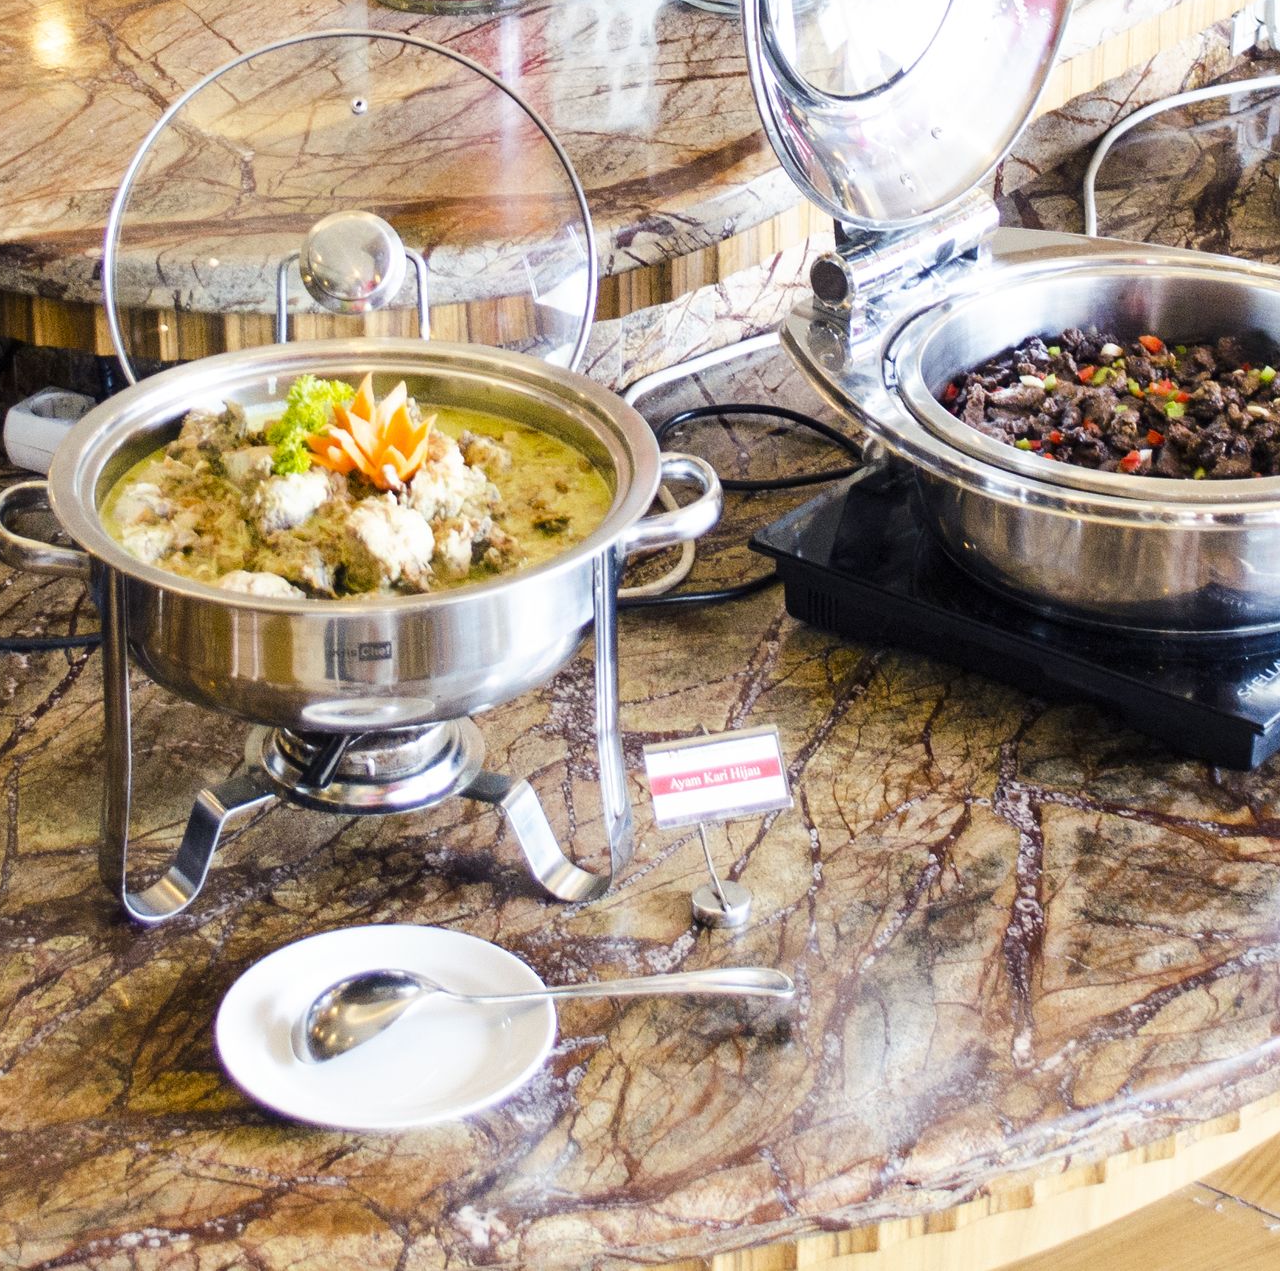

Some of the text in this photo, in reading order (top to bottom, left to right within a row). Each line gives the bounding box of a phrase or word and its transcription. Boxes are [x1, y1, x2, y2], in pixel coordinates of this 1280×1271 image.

[670, 765, 762, 791] Ayam Kari Hijau
